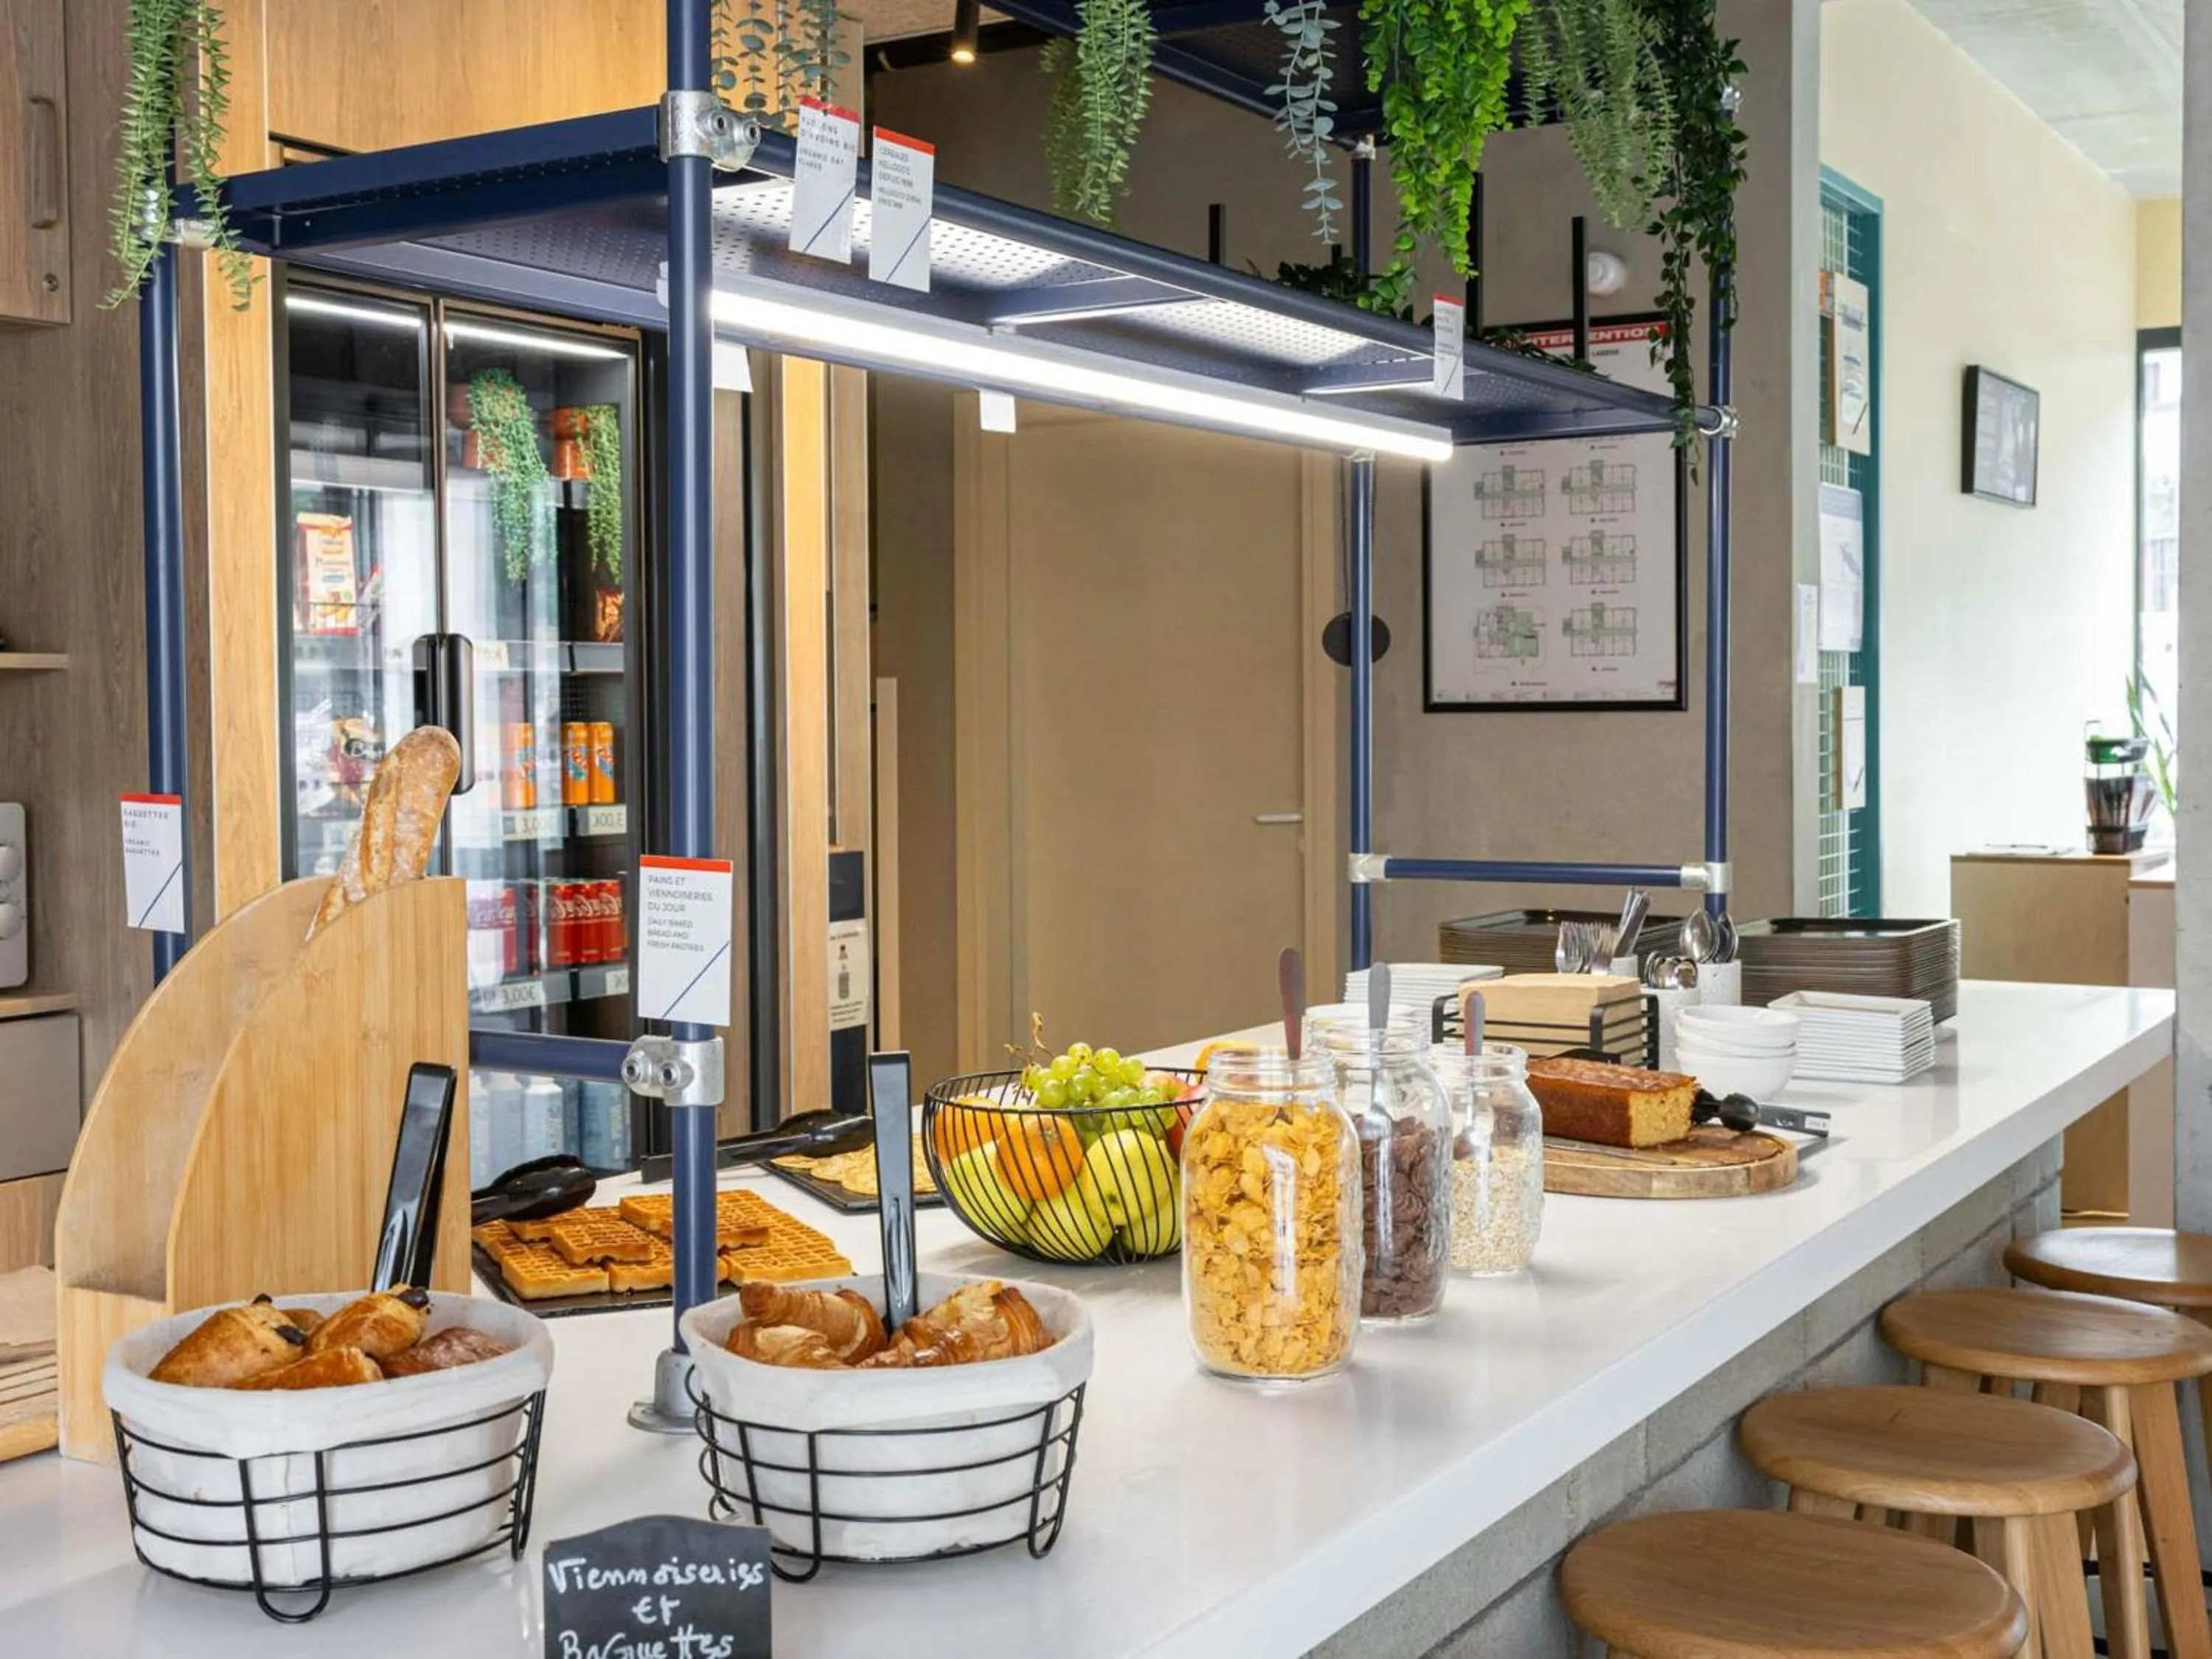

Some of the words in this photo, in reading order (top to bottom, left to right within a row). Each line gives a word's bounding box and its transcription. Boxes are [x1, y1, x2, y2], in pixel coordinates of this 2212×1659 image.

[648, 874, 672, 885] PAINS
[675, 877, 686, 886] ET
[648, 888, 713, 901] VIENNOISERIES
[648, 901, 661, 911] DU
[661, 902, 686, 913] JOUR
